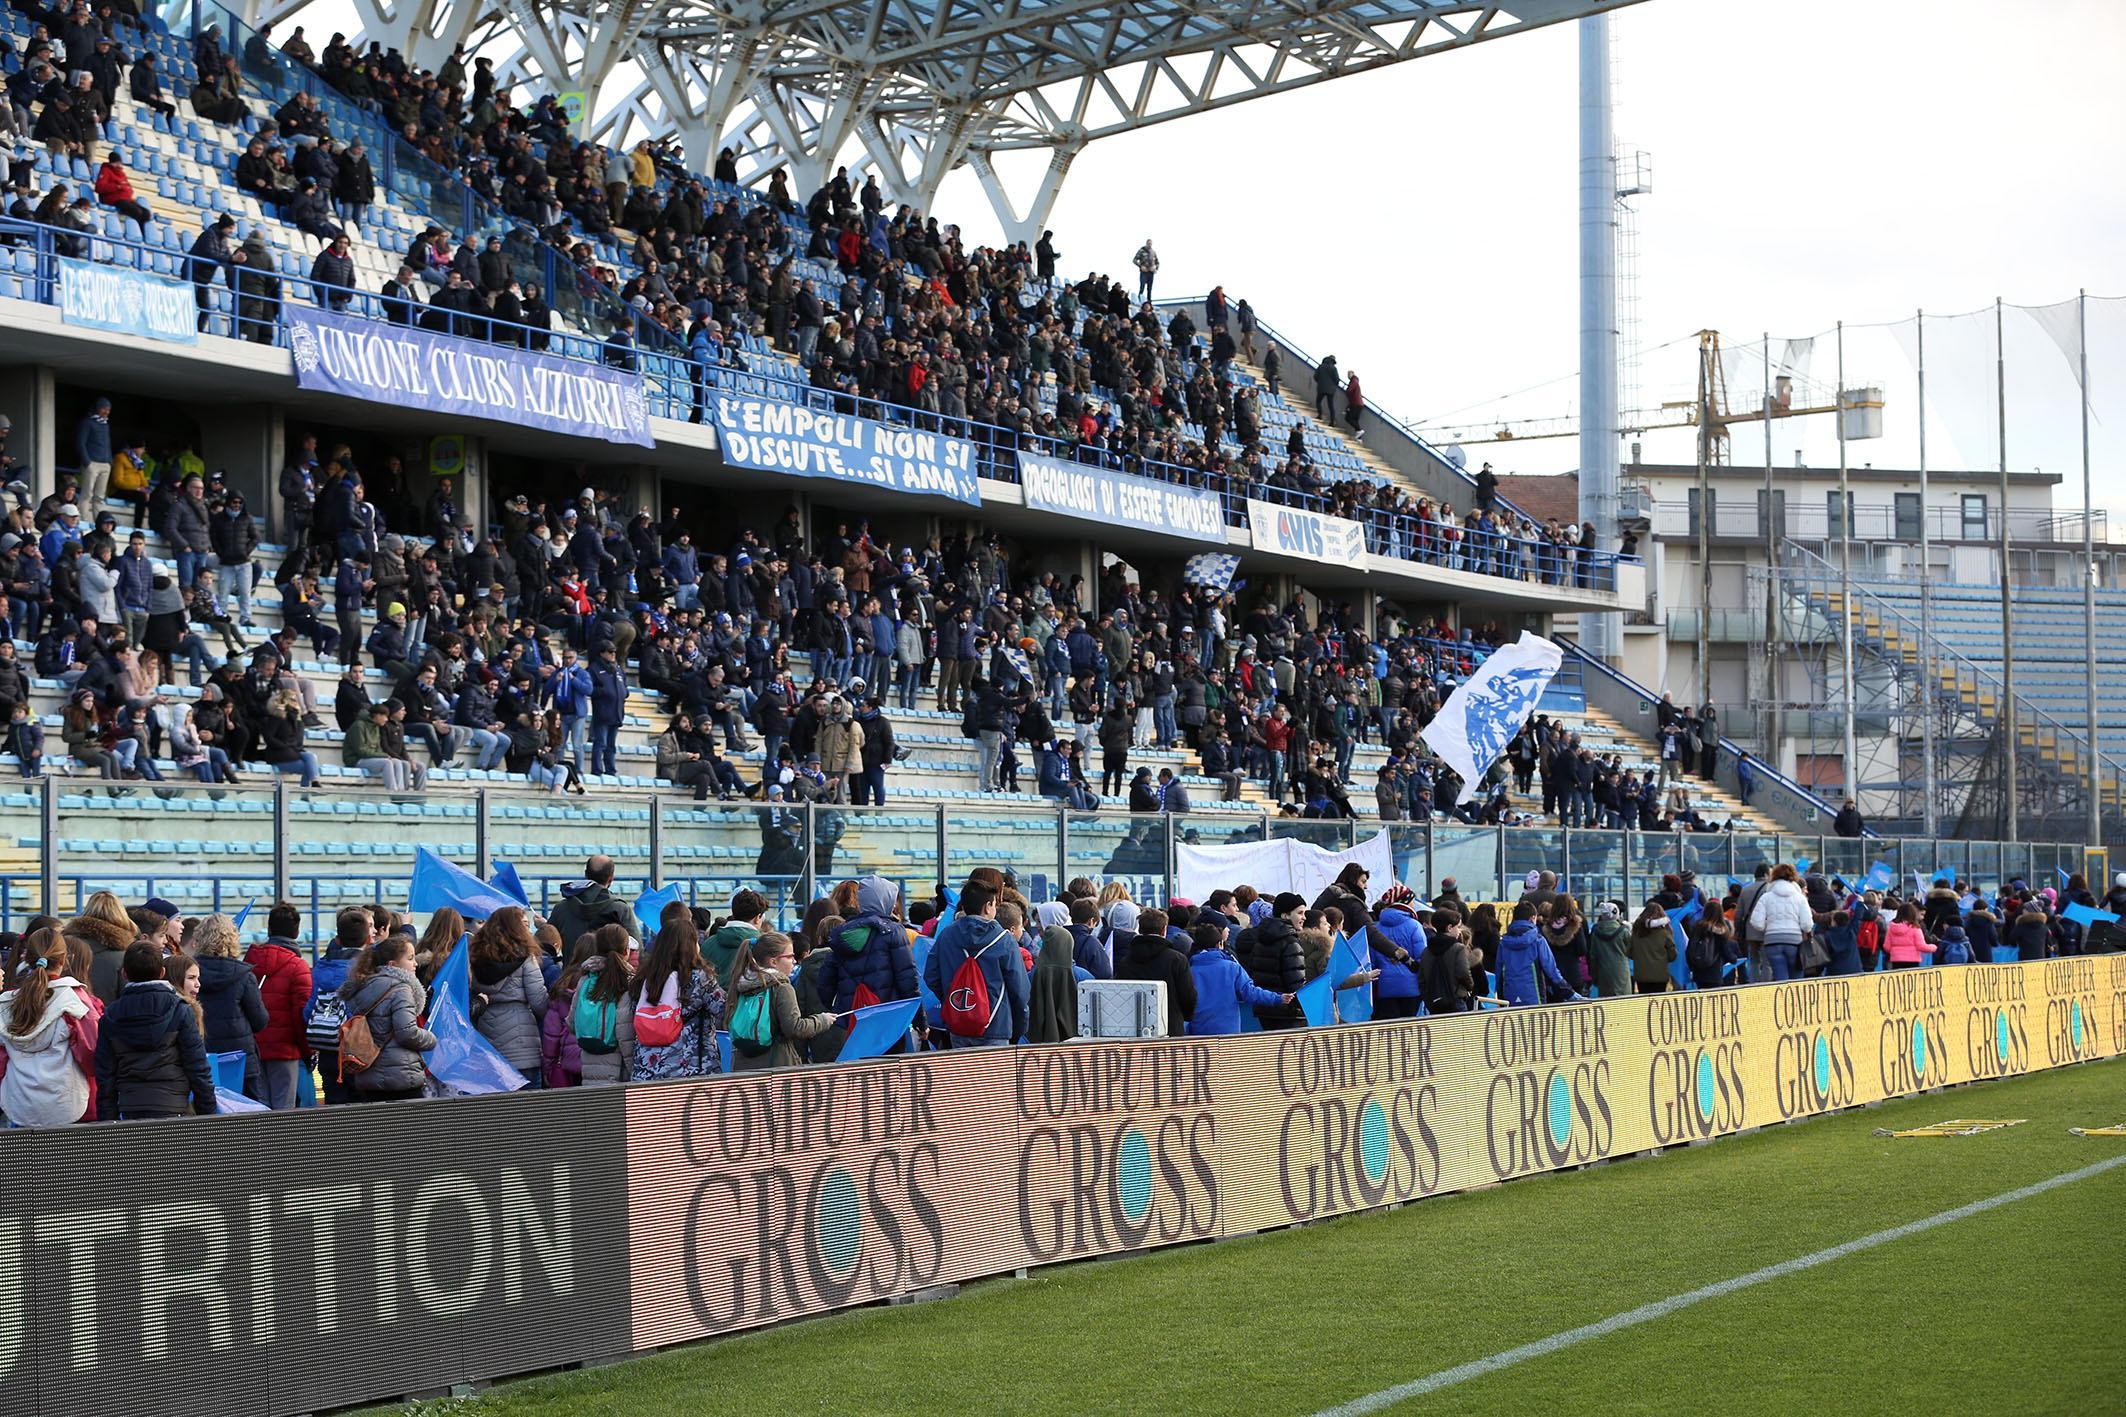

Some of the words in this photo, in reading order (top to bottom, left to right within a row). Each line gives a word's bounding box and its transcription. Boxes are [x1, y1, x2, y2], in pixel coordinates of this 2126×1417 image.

[315, 324, 429, 395] UNIONE
[430, 347, 517, 409] CLUBS
[521, 364, 628, 430] AZZURRI
[719, 397, 863, 450] L'EMPOLI
[874, 426, 936, 463] NON
[944, 440, 970, 471] SI
[902, 461, 959, 497] AMA
[1023, 461, 1097, 513] ORGOGLIOSI
[1100, 479, 1116, 517] DI
[1118, 482, 1164, 527] ESSERE
[1165, 492, 1222, 535] EMPOLESI
[1277, 510, 1324, 558] AVIS
[1773, 980, 1852, 1031] COMPUTER
[1877, 970, 1945, 1015] COMPUTER
[1965, 966, 2026, 1004] COMPUTER
[2043, 958, 2096, 997] COMPUTER
[1483, 1005, 1609, 1070] COMPUTER
[1646, 993, 1742, 1047] COMPUTER
[1879, 1010, 1948, 1096] GROSS
[1966, 1003, 2029, 1079] GROSS
[2045, 993, 2098, 1066] GROSS
[1019, 1043, 1214, 1121] COMPUTER
[1277, 1024, 1436, 1098] COMPUTER
[1648, 1041, 1745, 1144] GROSS
[1775, 1024, 1855, 1119] GROSS
[682, 1062, 939, 1167] COMPUTER
[1485, 1058, 1613, 1178] GROSS
[1019, 1111, 1218, 1261] GROSS
[1278, 1083, 1440, 1221] GROSS
[683, 1141, 944, 1331] GROSS
